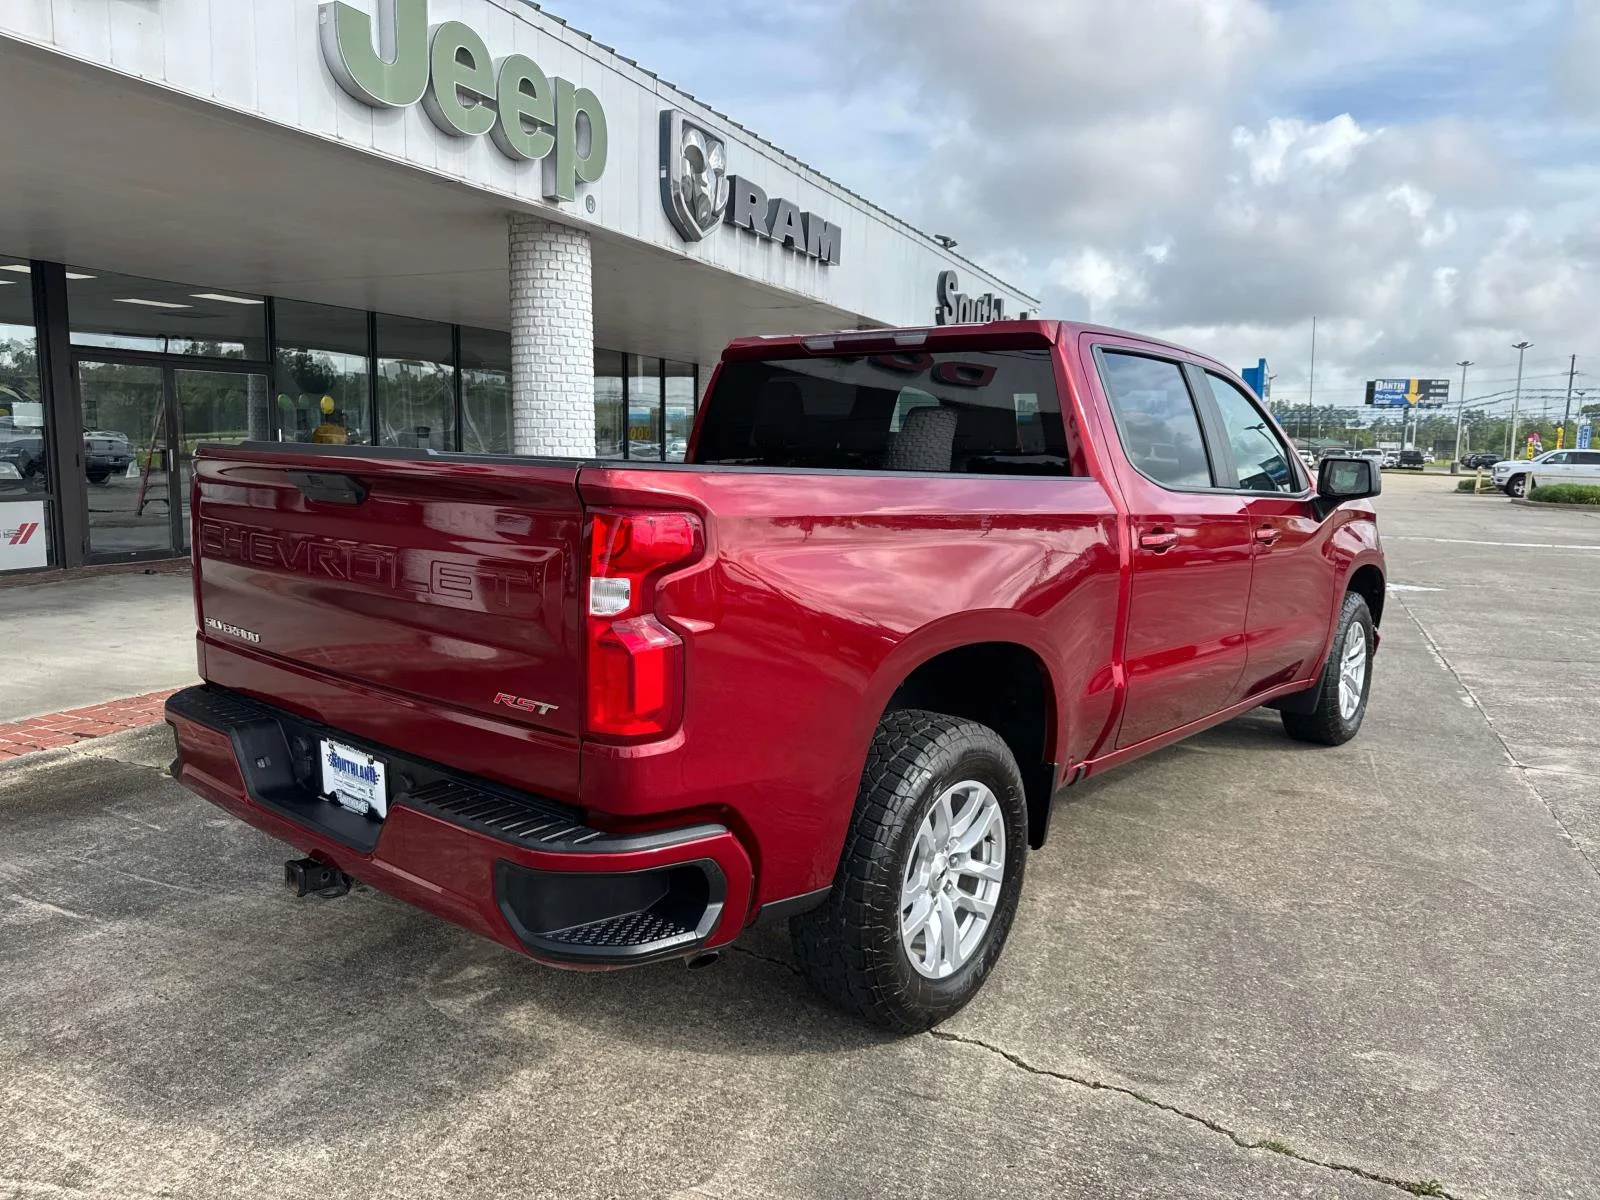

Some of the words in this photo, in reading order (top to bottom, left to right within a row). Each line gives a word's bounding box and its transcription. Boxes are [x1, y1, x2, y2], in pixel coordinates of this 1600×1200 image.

[318, 0, 608, 202] Jeep
[724, 174, 842, 266] RAM
[202, 523, 530, 608] CHEVROLET
[204, 616, 261, 643] SILVERADO
[493, 692, 559, 715] RST
[330, 752, 377, 785] SOUTHLAND
